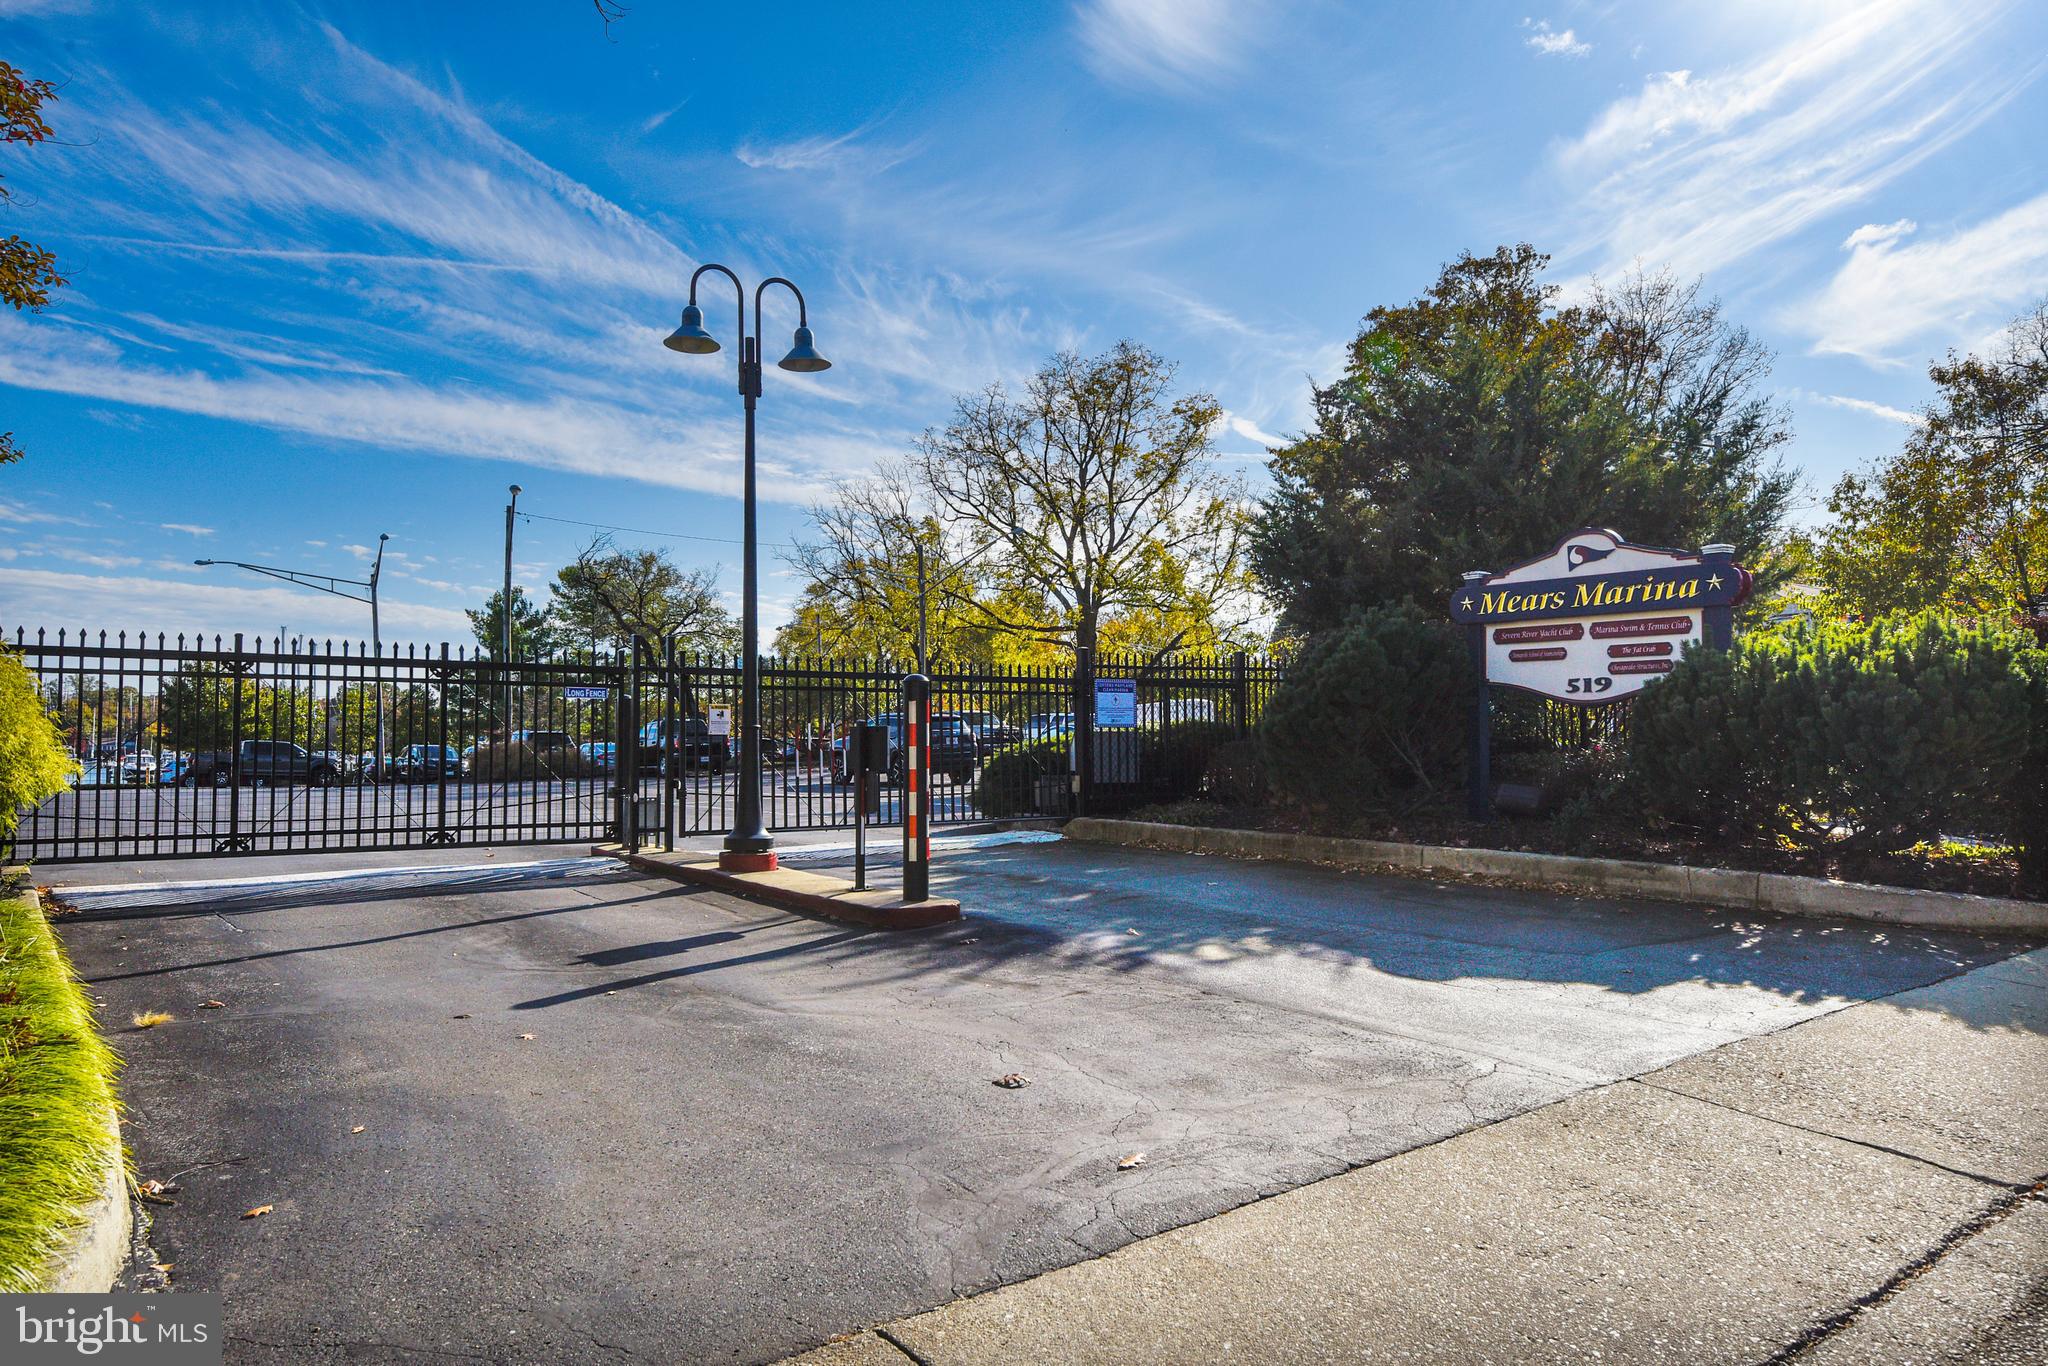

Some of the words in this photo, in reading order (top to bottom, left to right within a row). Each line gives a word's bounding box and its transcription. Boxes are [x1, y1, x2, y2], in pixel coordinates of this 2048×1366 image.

[1477, 590, 1566, 615] Mears
[1571, 576, 1700, 608] Marina
[1501, 631, 1521, 640] Severn
[1521, 630, 1538, 639] River
[1540, 629, 1557, 638] Yacht
[1558, 627, 1574, 636] Club
[1594, 626, 1619, 634] Marina
[1620, 624, 1638, 632] Swim
[1639, 623, 1645, 631] &
[1645, 622, 1669, 631] Tennis
[1671, 619, 1687, 629] Club
[1632, 646, 1642, 654] Fat
[1642, 645, 1656, 653] Crab
[1565, 676, 1612, 693] 519
[567, 688, 584, 697] LONG
[585, 689, 606, 697] FENCE
